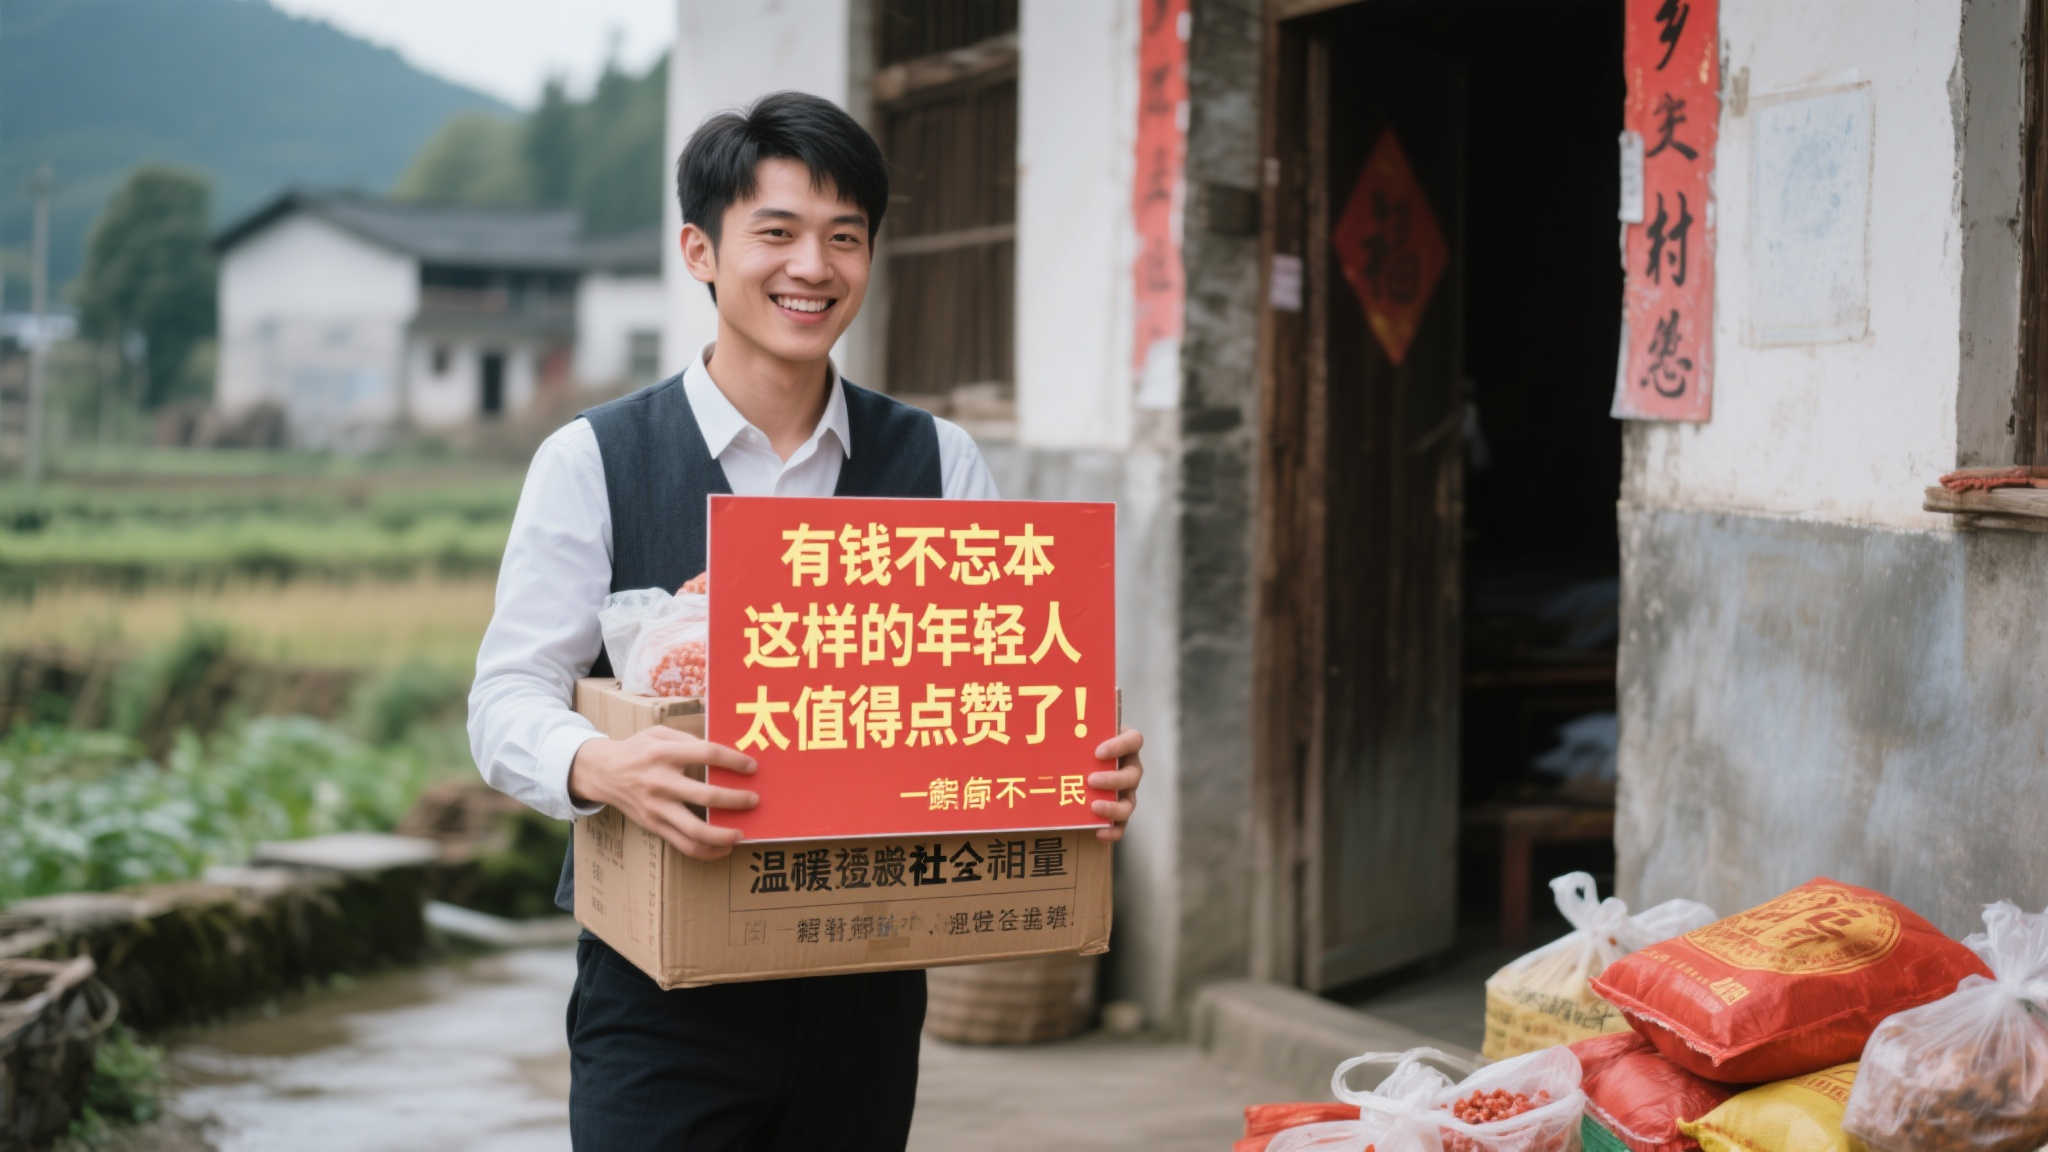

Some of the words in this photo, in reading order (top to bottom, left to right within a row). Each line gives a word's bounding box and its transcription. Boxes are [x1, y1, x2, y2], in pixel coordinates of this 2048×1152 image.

[781, 522, 1055, 587] 有钱不忘本
[743, 600, 1082, 669] 这样的年轻人
[735, 681, 1088, 752] 太值得点赞了！
